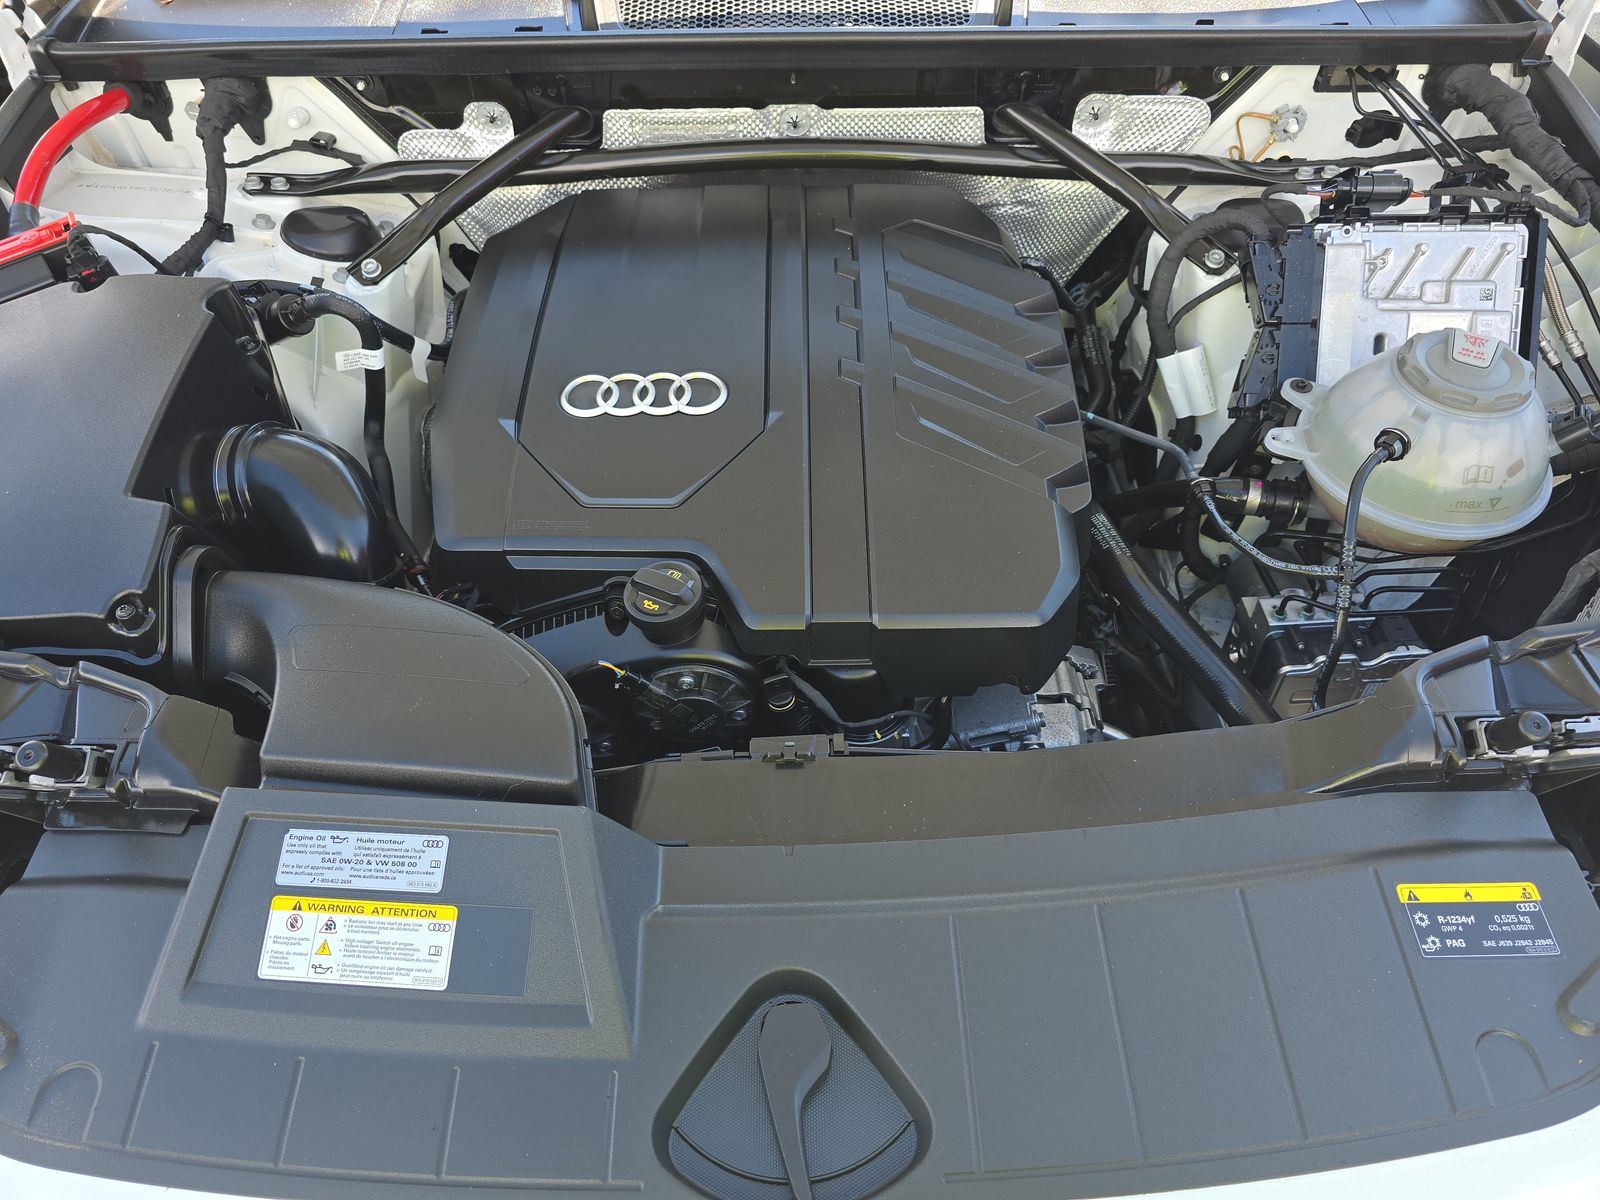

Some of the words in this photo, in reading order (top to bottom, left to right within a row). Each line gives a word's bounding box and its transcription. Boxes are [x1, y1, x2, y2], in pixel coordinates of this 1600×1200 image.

[1455, 500, 1481, 509] max
[308, 903, 365, 914] WARNING
[371, 907, 437, 919] ATTENTION
[1437, 915, 1475, 925] R-1234yf
[1494, 915, 1517, 923] 0,525
[1519, 915, 1530, 923] kg
